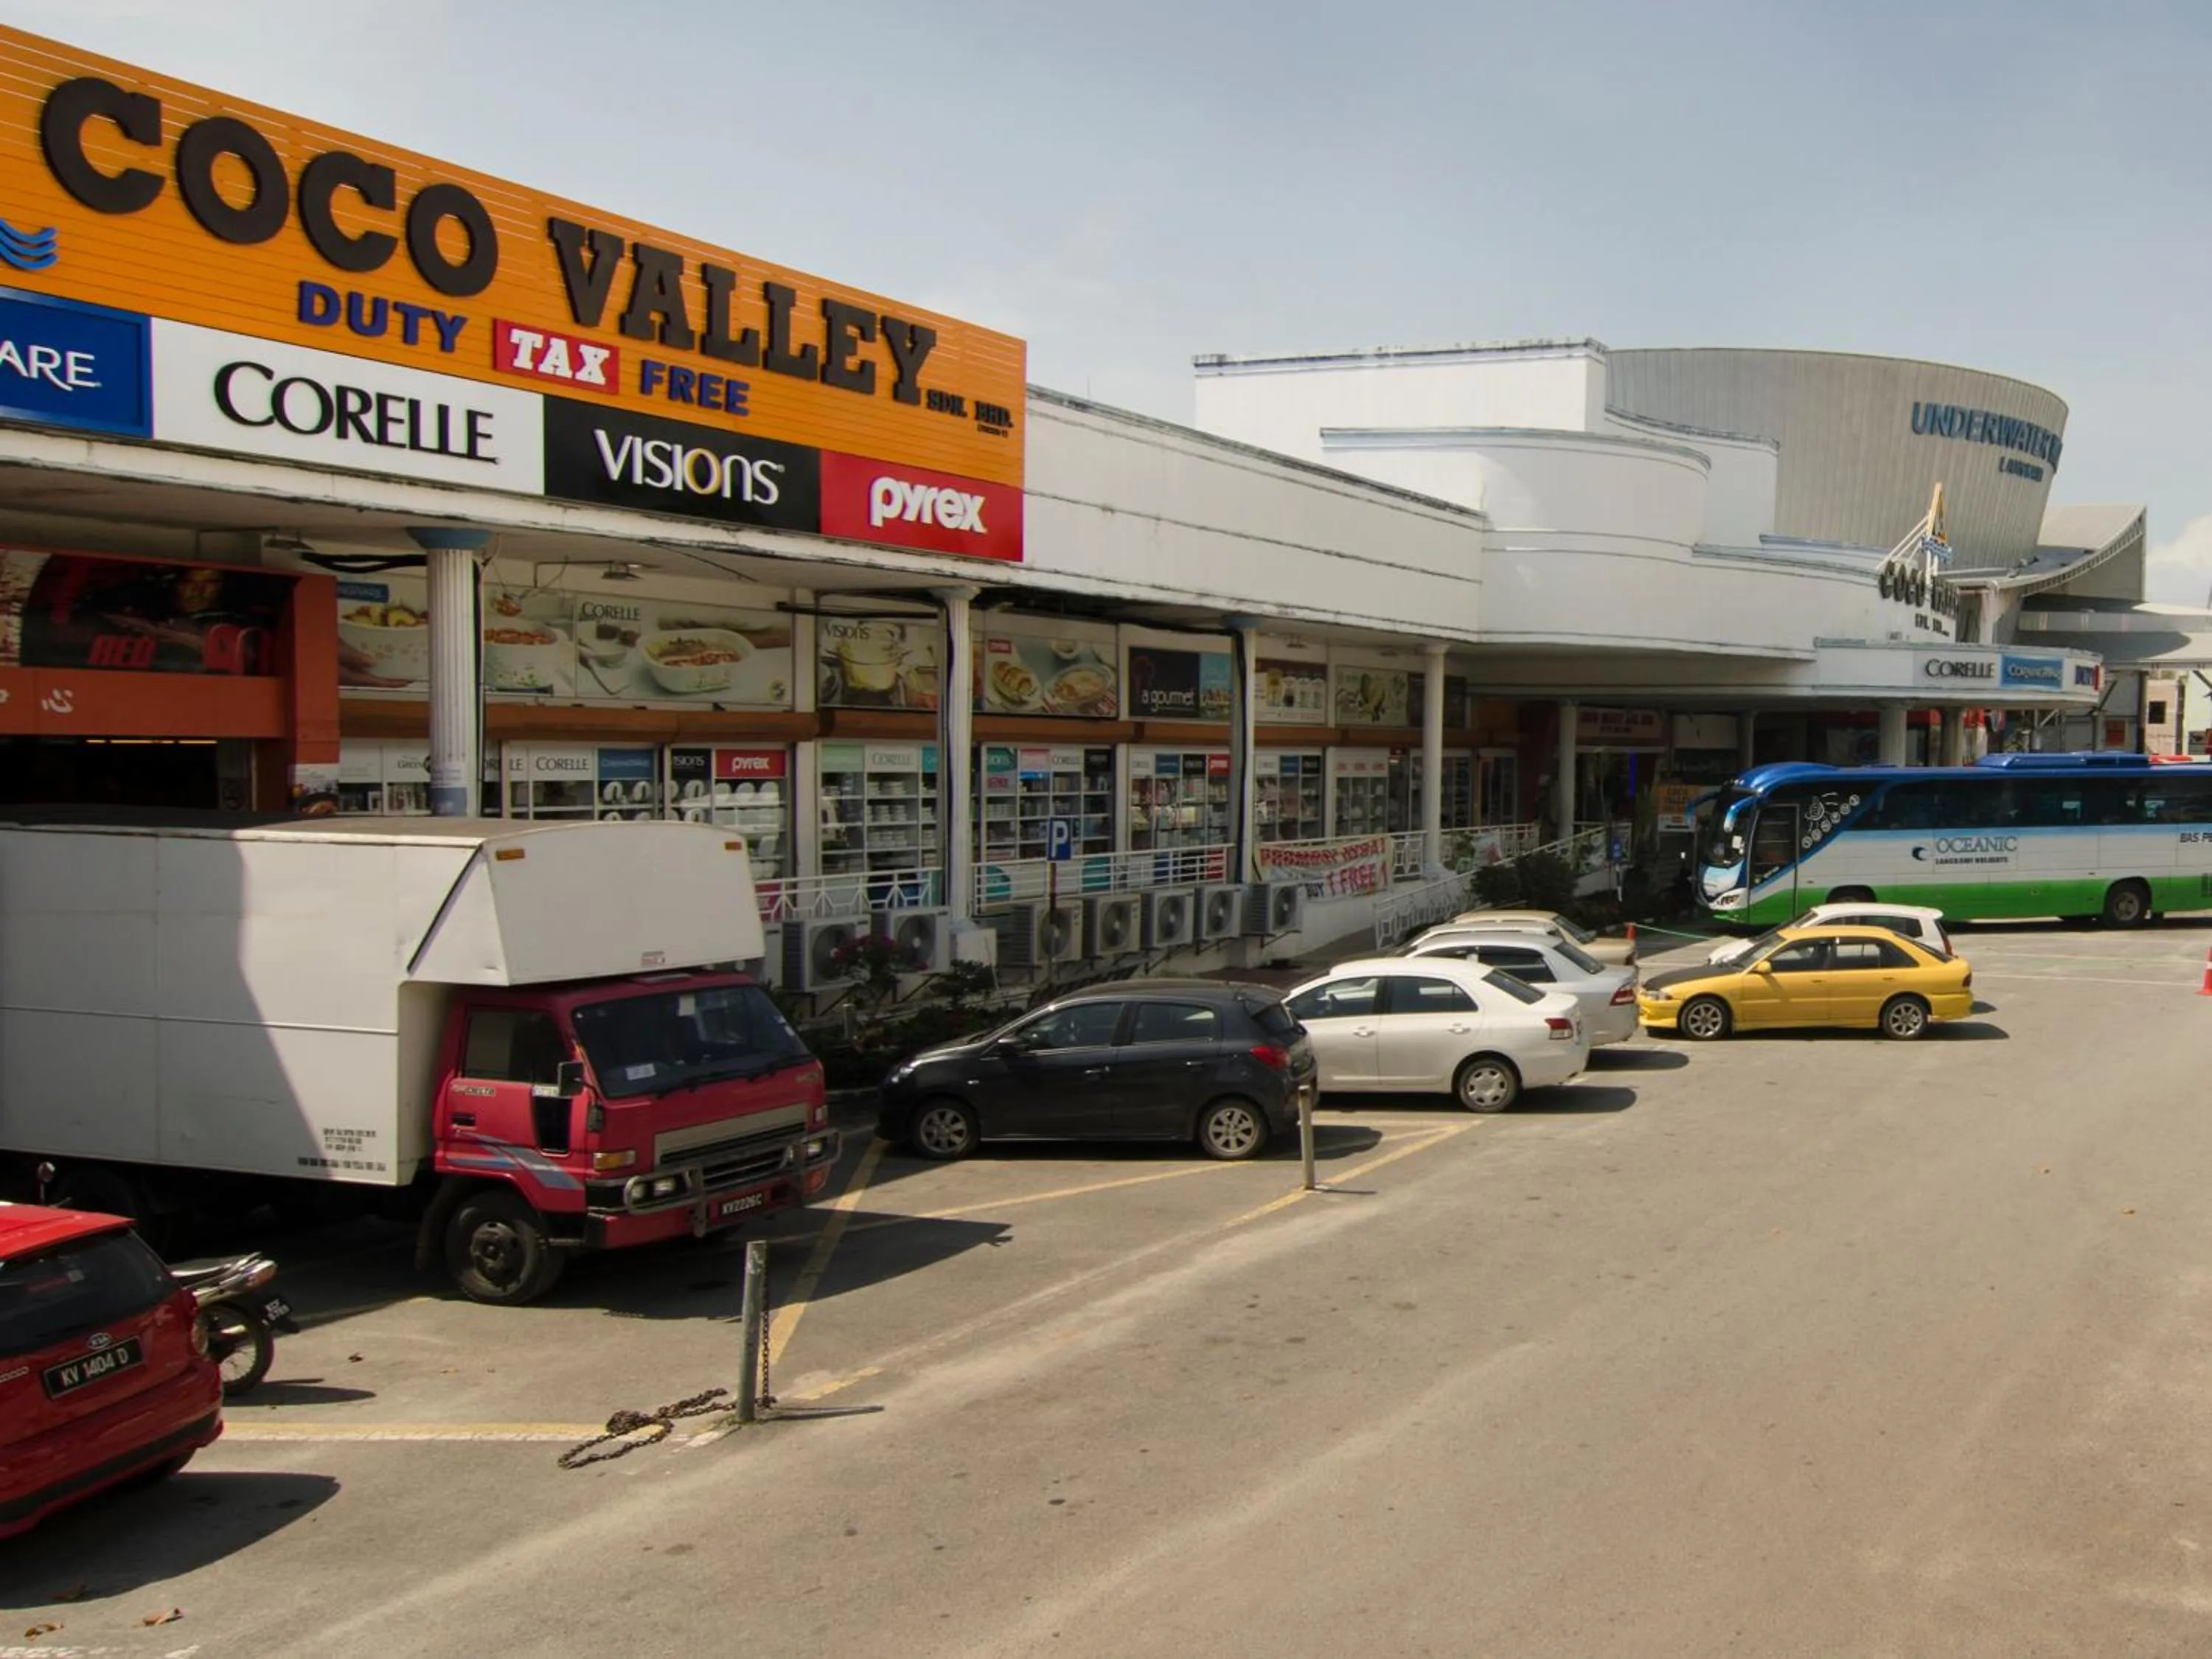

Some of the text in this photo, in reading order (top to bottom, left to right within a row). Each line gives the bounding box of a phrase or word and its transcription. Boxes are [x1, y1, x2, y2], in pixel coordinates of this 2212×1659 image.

[41, 77, 936, 405] COCO VALLEY
[297, 280, 750, 416] DUTY TAX FREE
[214, 361, 499, 463] CORELLE
[594, 428, 780, 505] VISIONS
[869, 476, 987, 533] pyrex
[581, 601, 641, 622] CORELLE
[1924, 658, 1995, 680] CORELLE
[536, 756, 590, 771] CORELLE
[731, 757, 770, 773] pyrex
[1051, 821, 1068, 857] P
[1936, 835, 2017, 854] OCEANIC
[61, 1347, 129, 1387] KV 1404 D
